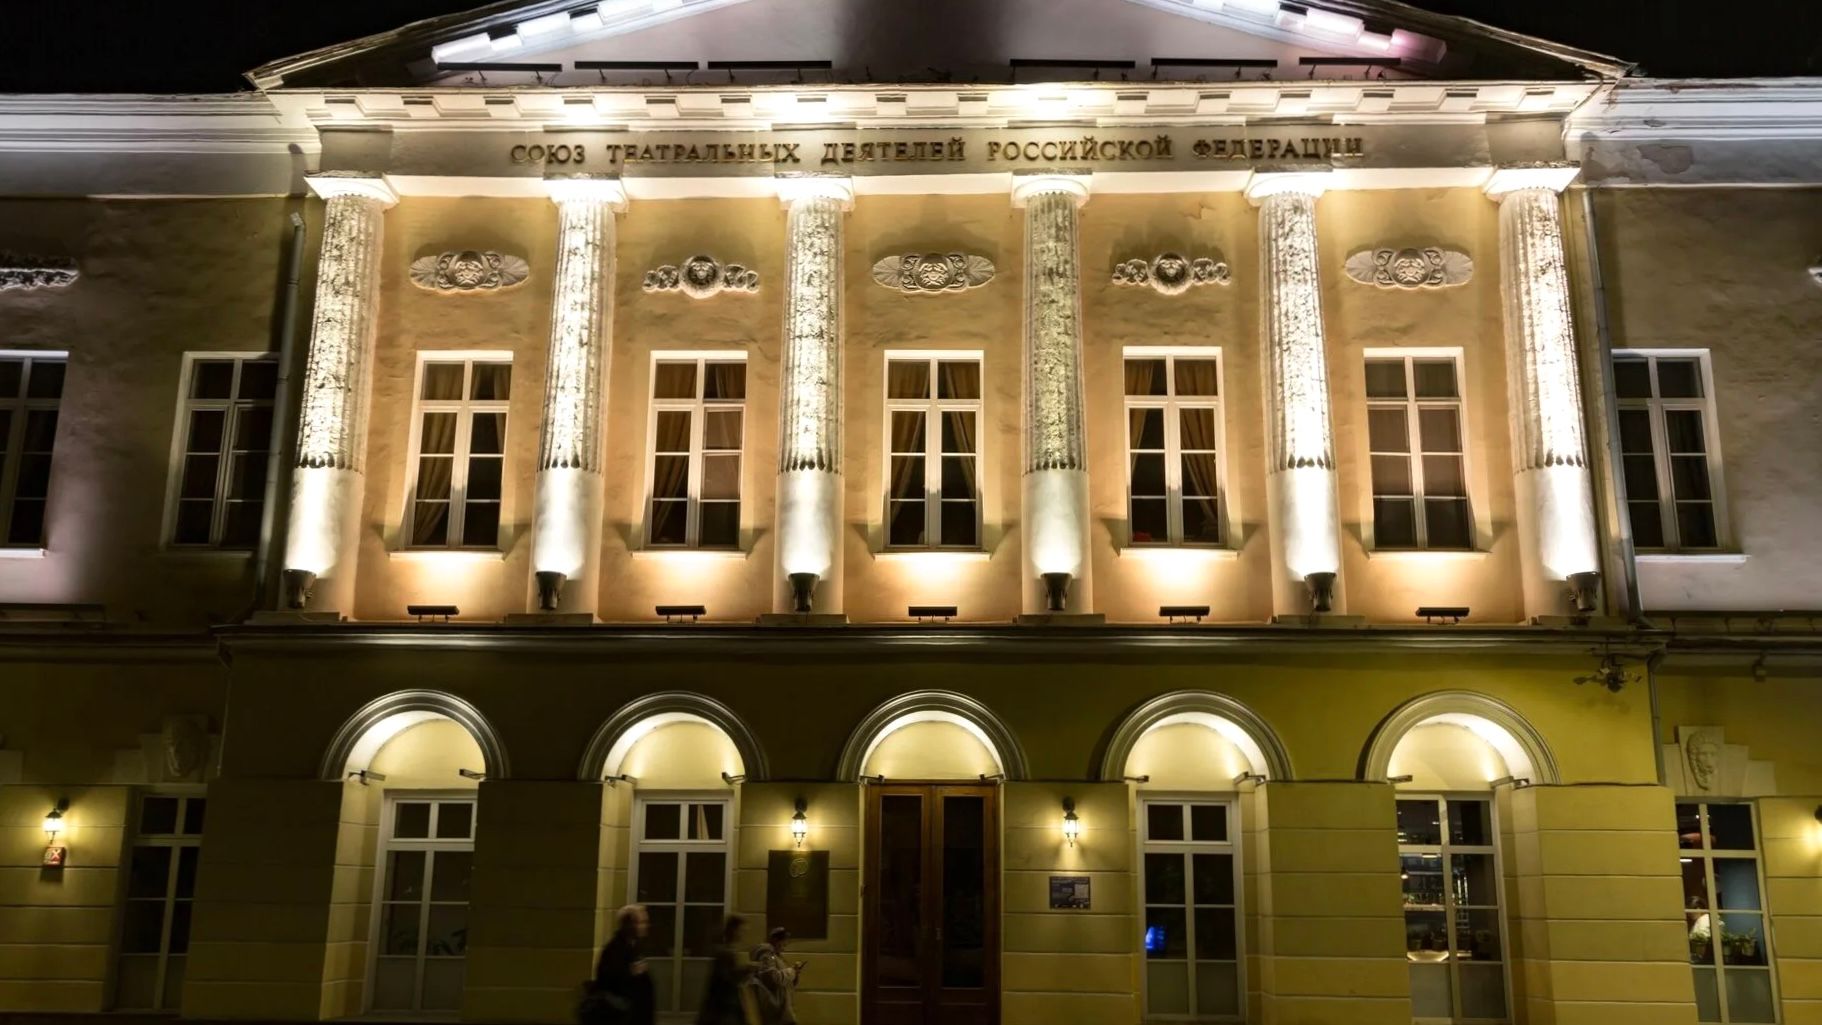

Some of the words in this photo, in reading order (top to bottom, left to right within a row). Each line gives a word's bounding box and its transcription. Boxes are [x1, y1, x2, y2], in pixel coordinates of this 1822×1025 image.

[511, 144, 586, 164] СОЮЗ
[606, 144, 801, 164] ТЕАТРАЛЬНЫХ
[820, 136, 966, 165] ДЕЯТЕЛЕЙ
[987, 135, 1175, 160] РОССИЙСКОЙ
[1192, 138, 1363, 161] ФЕДЕРАЦИИ
